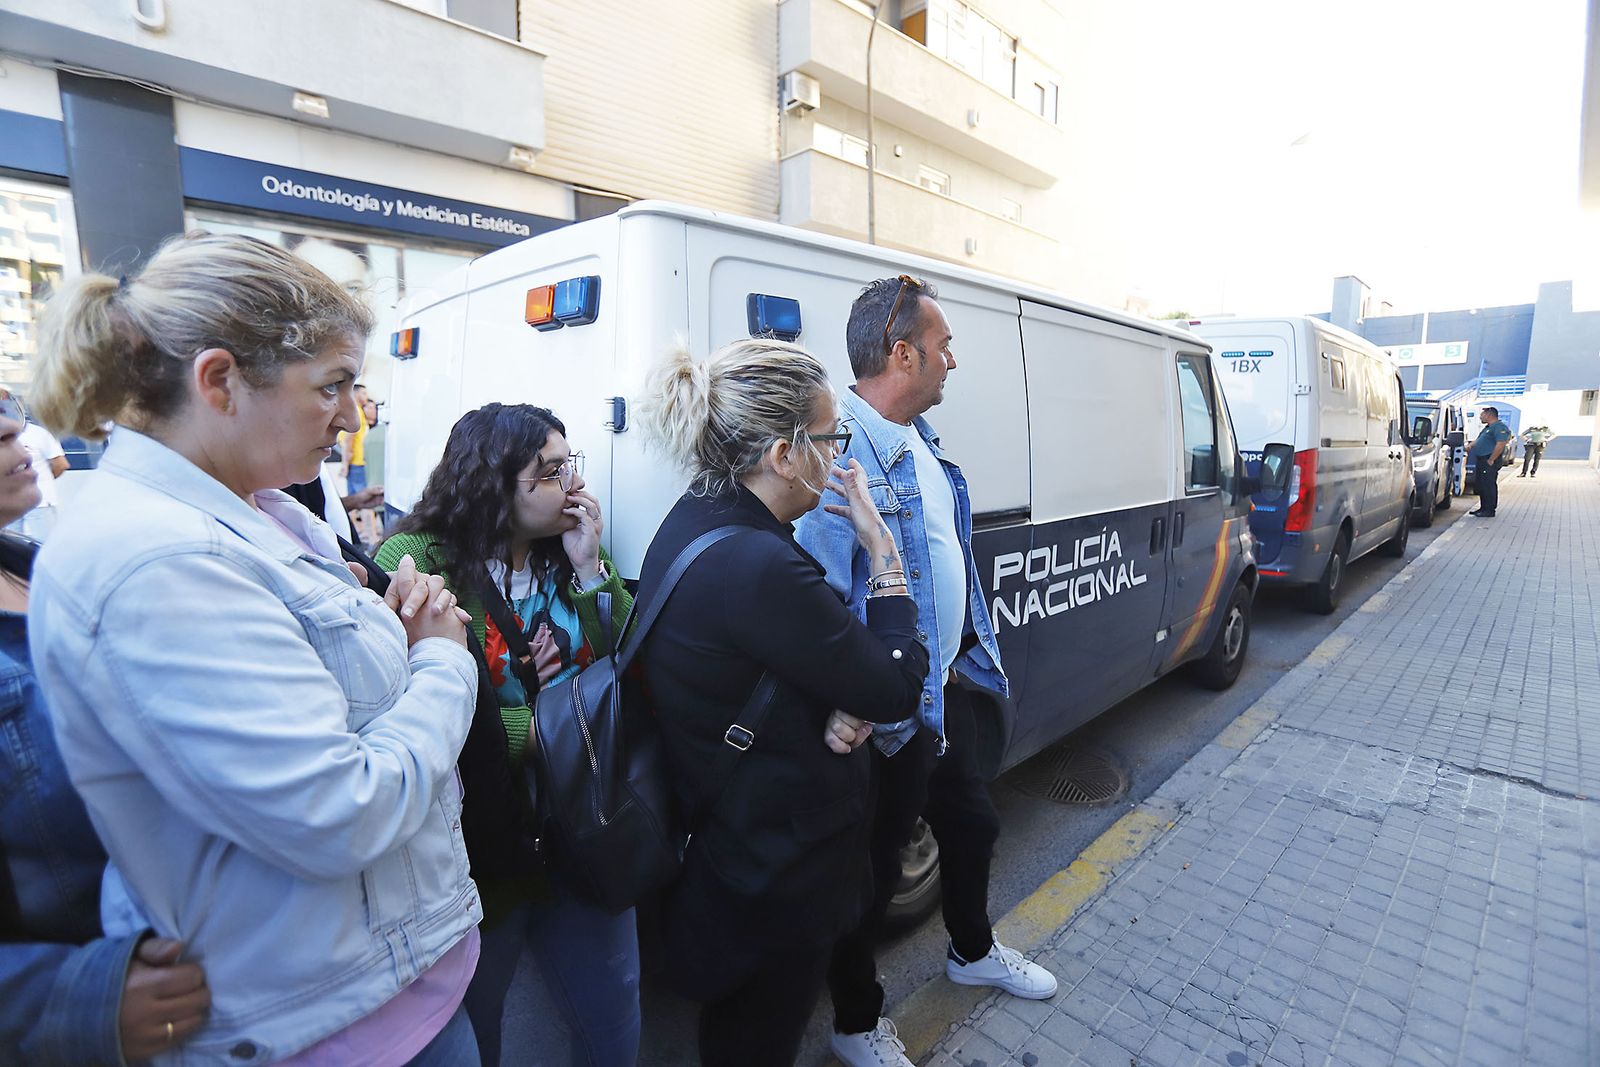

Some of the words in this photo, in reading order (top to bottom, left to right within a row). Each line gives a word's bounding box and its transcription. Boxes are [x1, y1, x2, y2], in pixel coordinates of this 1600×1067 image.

[261, 175, 380, 212] Odontología
[382, 201, 394, 216] y
[396, 199, 470, 228] Medicina
[471, 212, 531, 237] Estética
[1230, 359, 1262, 373] 1BX
[992, 526, 1123, 591] POLICÍA
[992, 559, 1148, 635] NACIONAL
